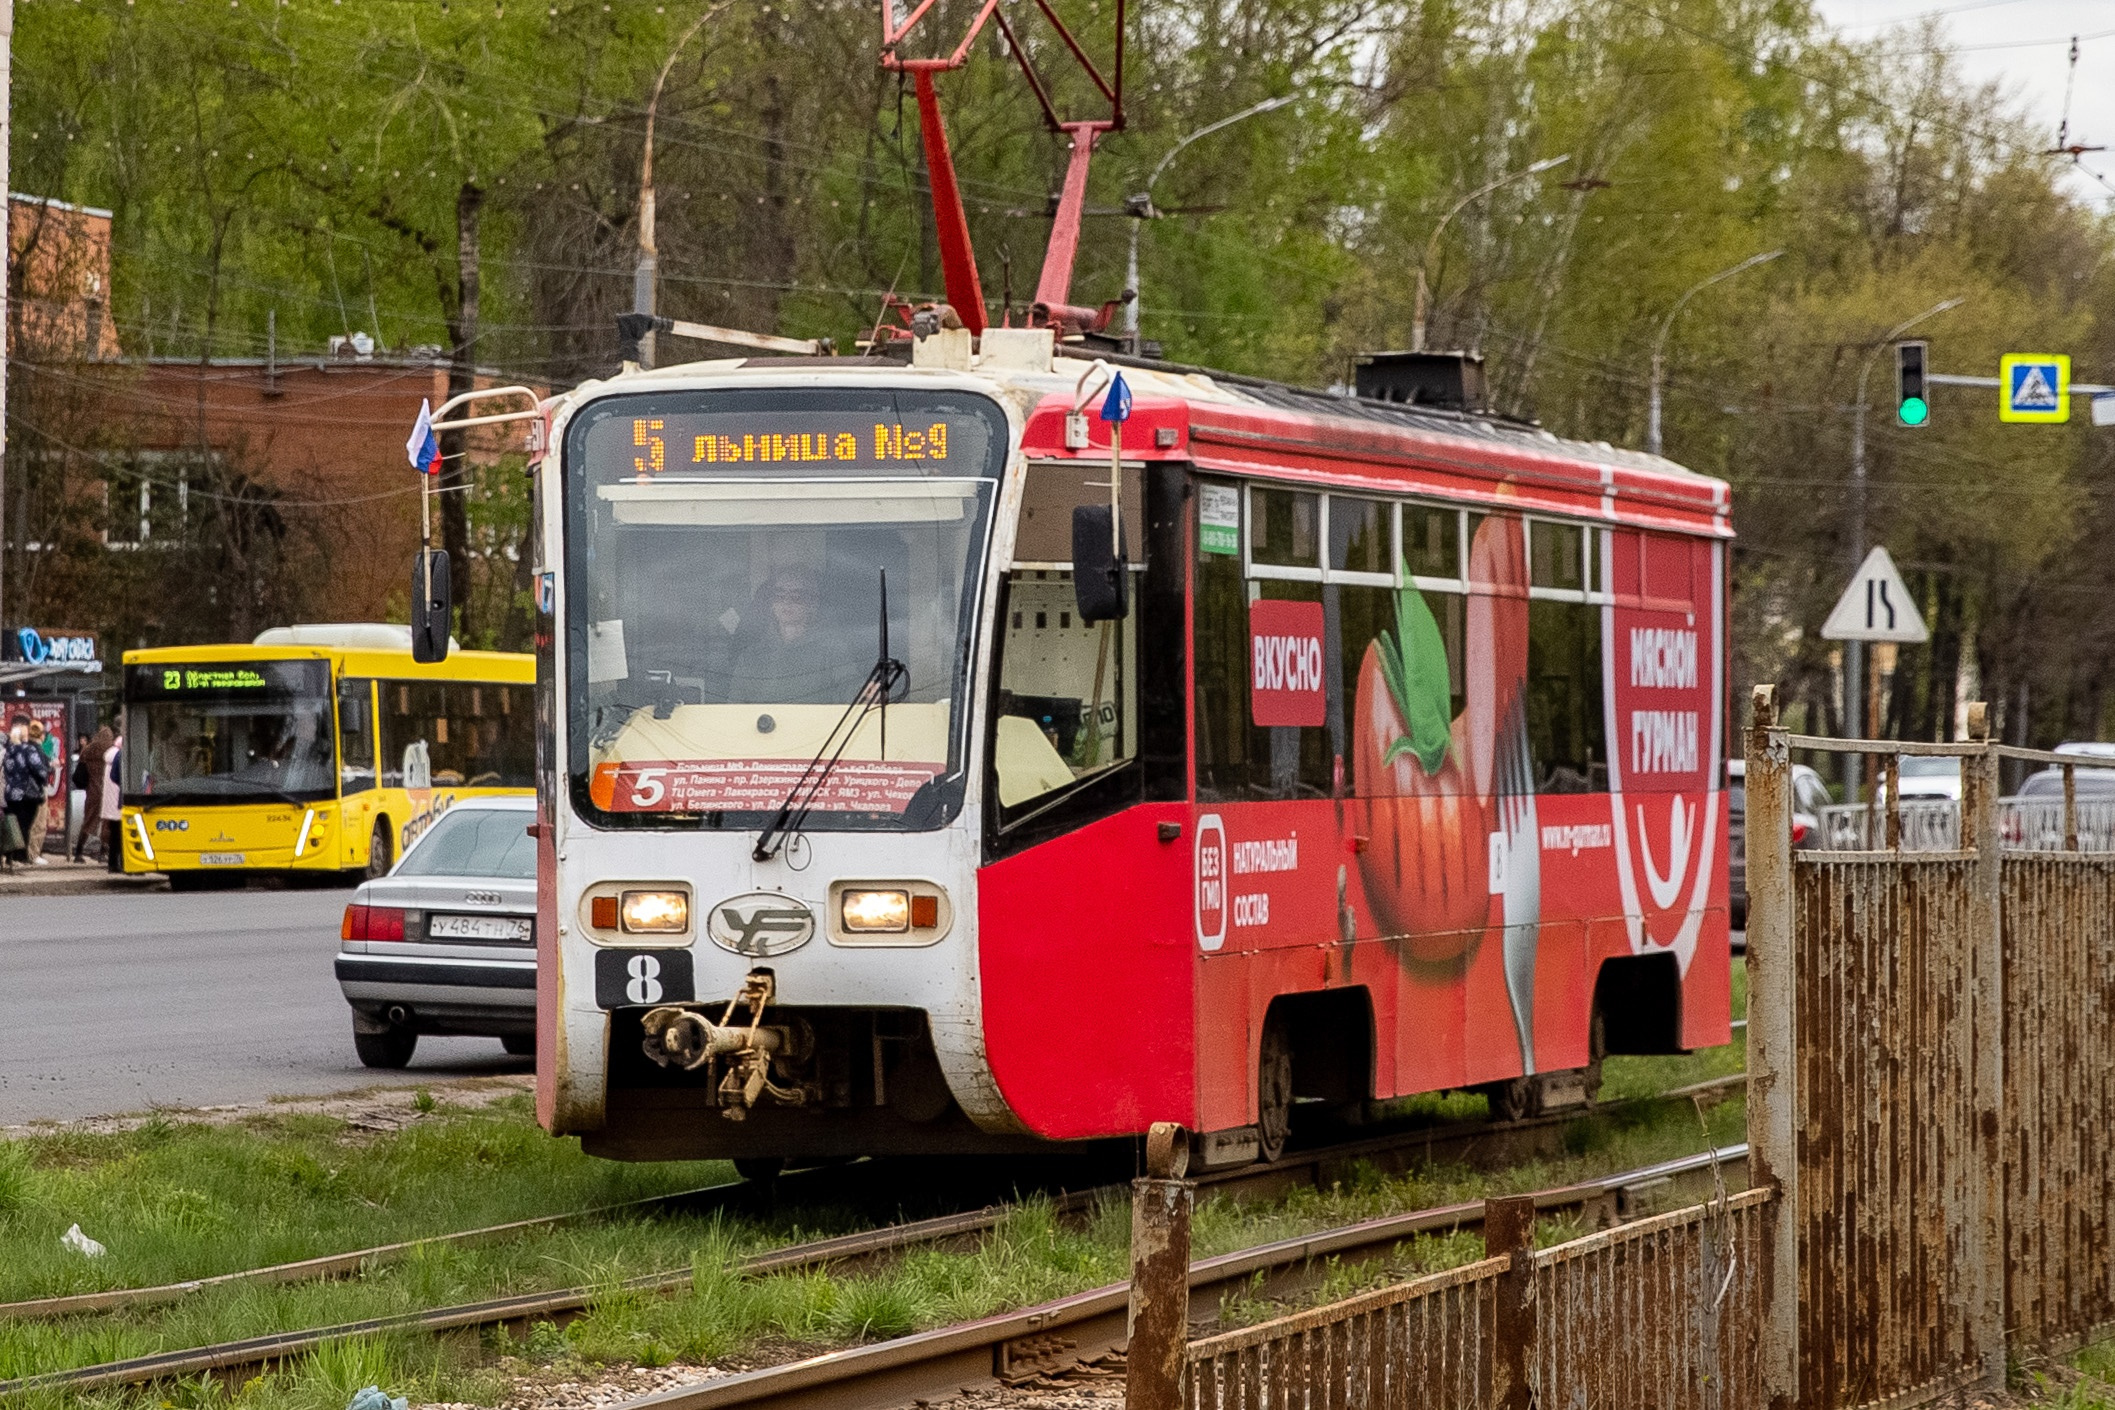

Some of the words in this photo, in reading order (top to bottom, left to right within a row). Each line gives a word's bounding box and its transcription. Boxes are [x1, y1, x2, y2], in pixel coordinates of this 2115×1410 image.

[633, 419, 664, 472] 5
[692, 433, 856, 462] льница
[874, 423, 947, 460] №9
[1254, 635, 1321, 692] ВКУСНО
[1630, 612, 1698, 690] МЯСНОЙ
[163, 670, 180, 690] 23
[1631, 710, 1698, 773] ГУРМАН
[631, 767, 668, 807] 5
[686, 788, 716, 797] Омега
[884, 789, 915, 800] Чехов
[750, 774, 820, 786] Дзержинсого
[767, 799, 826, 811] Дорыина
[1201, 846, 1220, 877] БЕЗ
[1233, 830, 1298, 874] НАТУРАЛЬНЫЙ
[1201, 880, 1220, 911] ГМО
[1234, 893, 1269, 927] СОСТАВ
[626, 954, 663, 1004] 8
